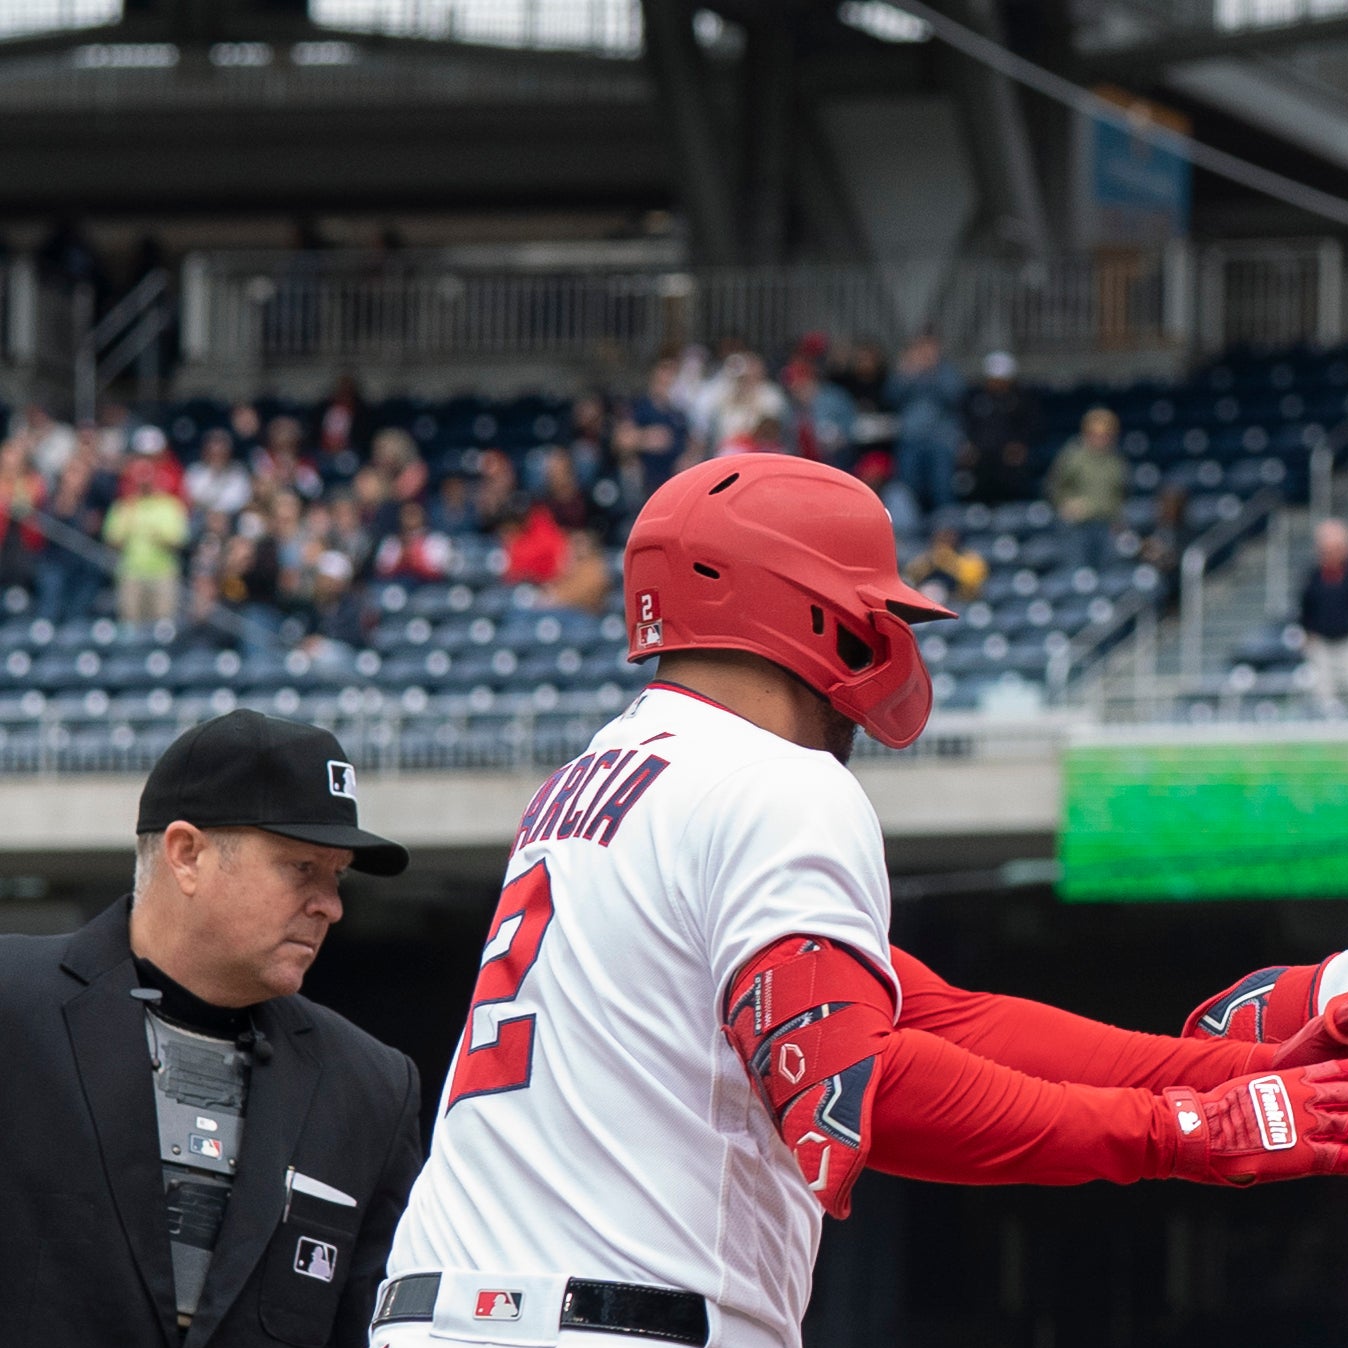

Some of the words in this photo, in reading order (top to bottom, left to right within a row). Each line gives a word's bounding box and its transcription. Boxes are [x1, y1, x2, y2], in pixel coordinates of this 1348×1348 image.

[641, 594, 653, 621] 2
[508, 732, 676, 860] ARCÍA
[445, 857, 555, 1119] 2
